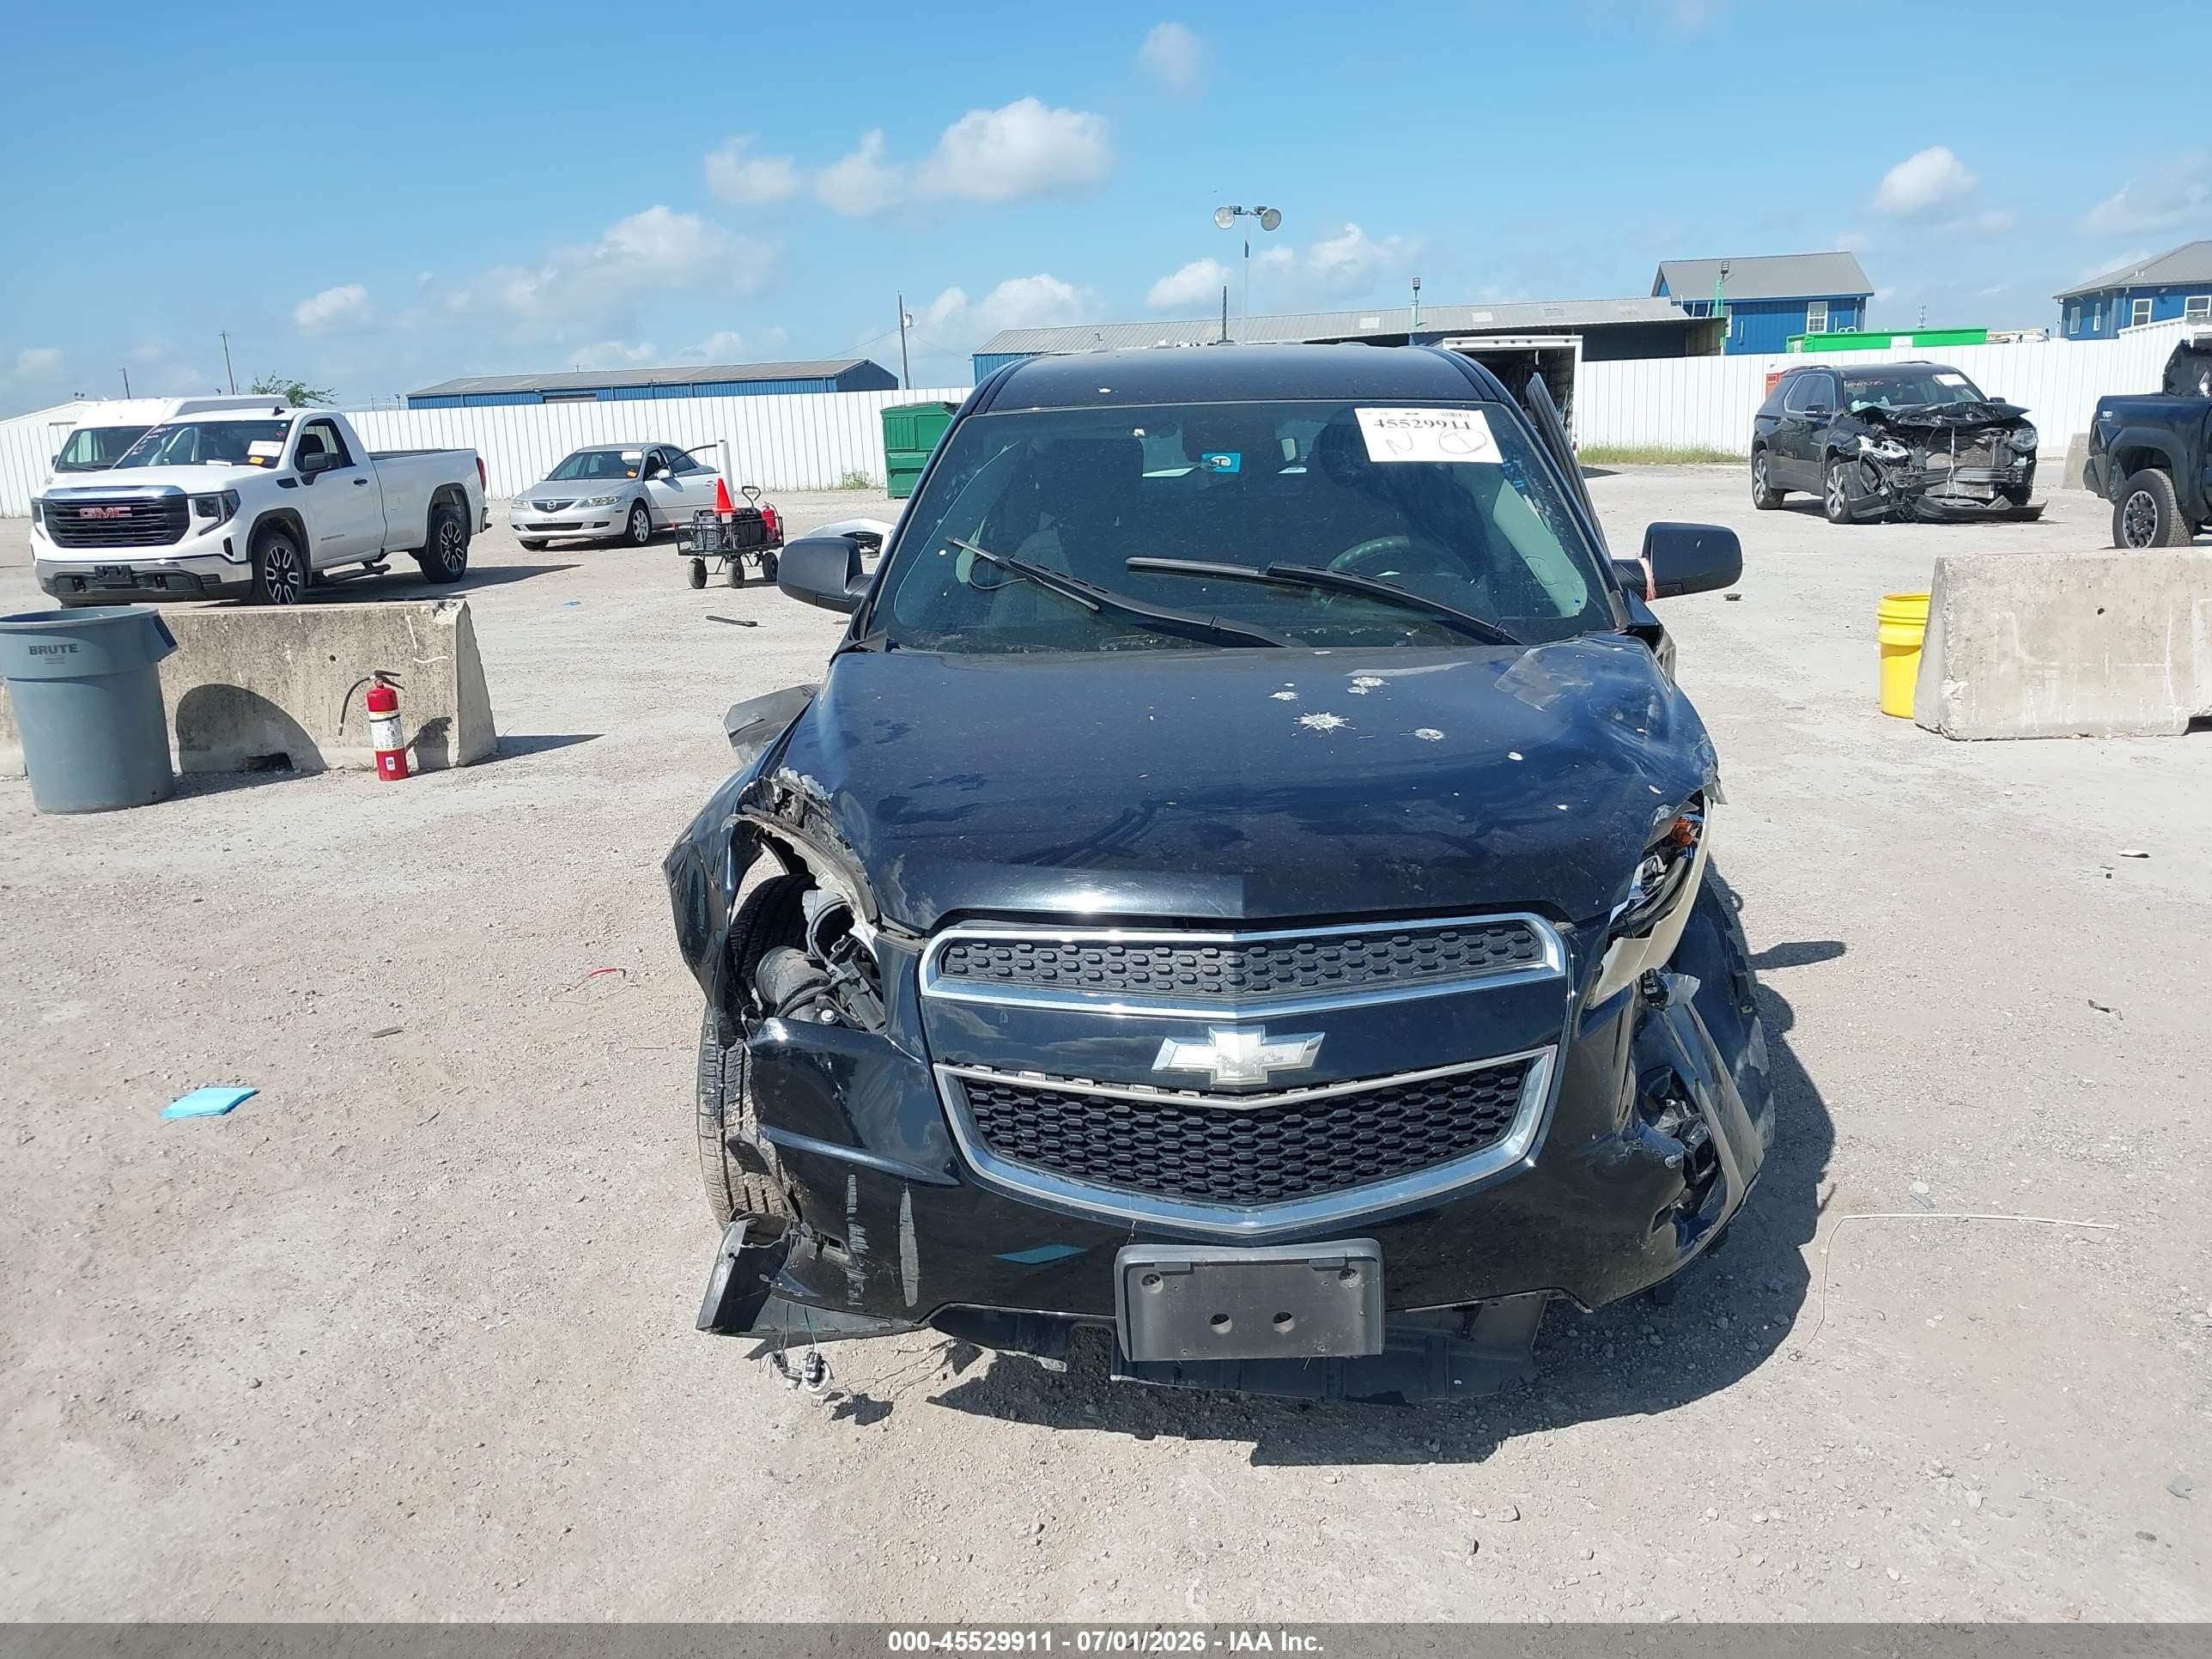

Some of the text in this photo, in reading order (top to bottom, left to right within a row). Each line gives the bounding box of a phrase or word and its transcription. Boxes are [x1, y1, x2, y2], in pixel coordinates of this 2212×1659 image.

[1374, 418, 1471, 430] 45529911
[79, 506, 132, 520] GMC
[28, 643, 79, 655] BRUTE
